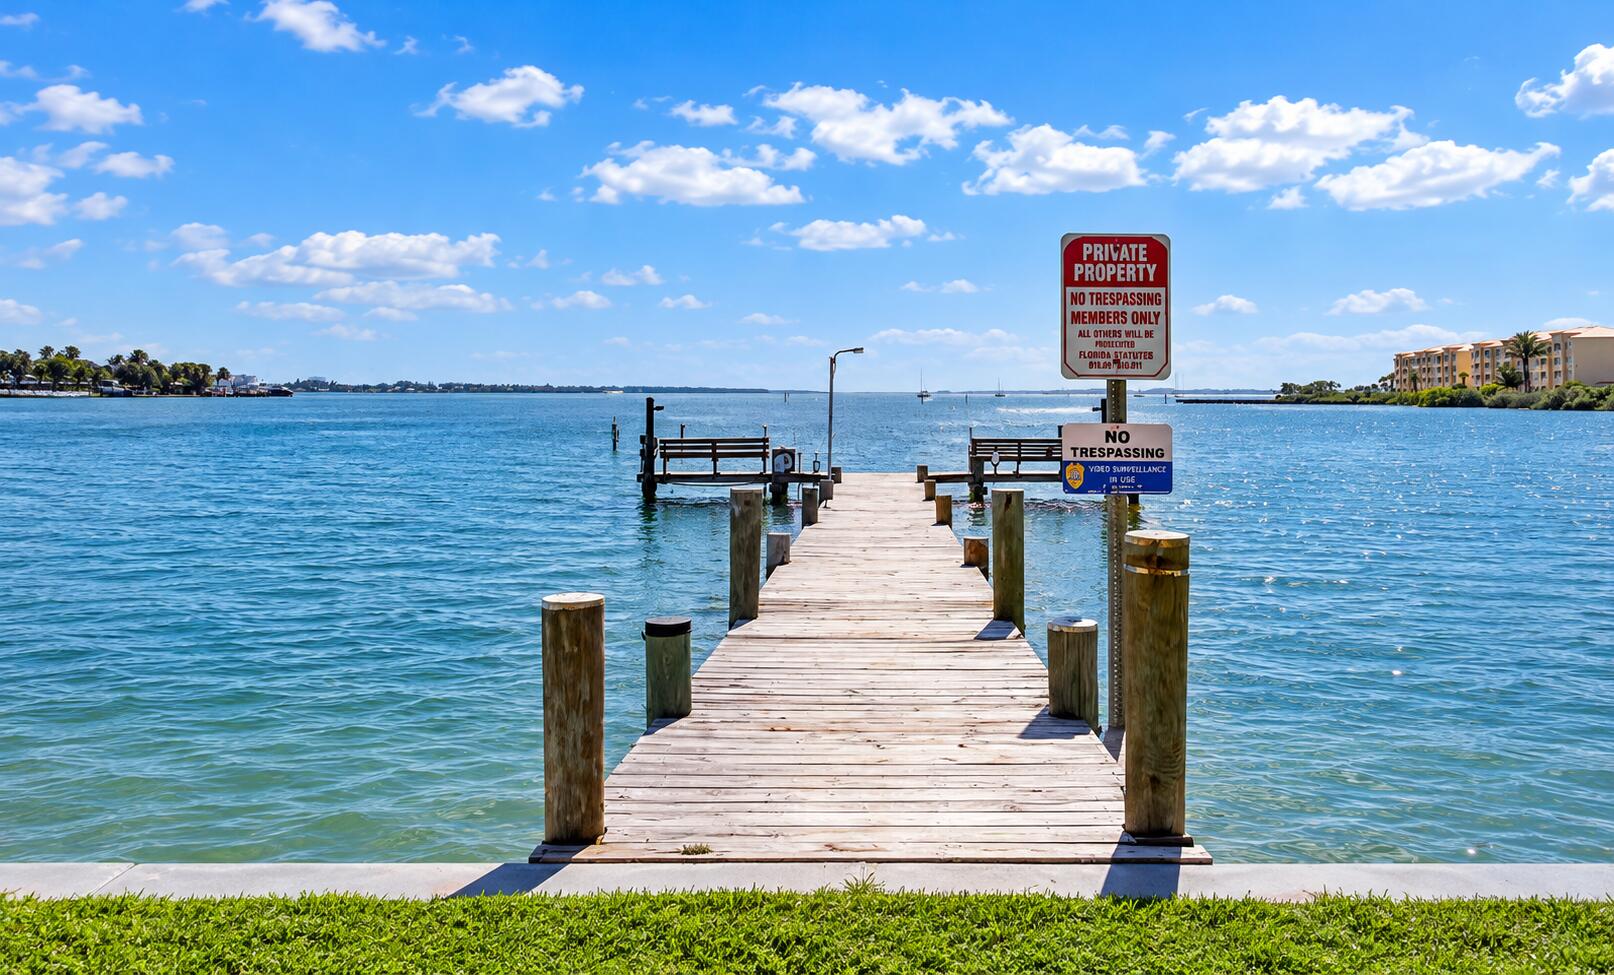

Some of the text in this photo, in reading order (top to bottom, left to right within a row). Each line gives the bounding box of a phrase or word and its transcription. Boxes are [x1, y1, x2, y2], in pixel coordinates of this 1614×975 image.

[1082, 243, 1148, 262] PRIVATE
[1074, 263, 1157, 282] PROPERTY
[1070, 291, 1162, 306] NO TRESPASSING
[1070, 310, 1161, 325] MEMBERS ONLY
[1078, 330, 1155, 338] ALL OTHERS WILL BE
[1079, 351, 1153, 360] FLORIDA STATUTES
[1104, 430, 1131, 444] NO
[1070, 447, 1165, 458] TRESPASSING
[1088, 465, 1167, 473] VIDEO SURVEILLANCE
